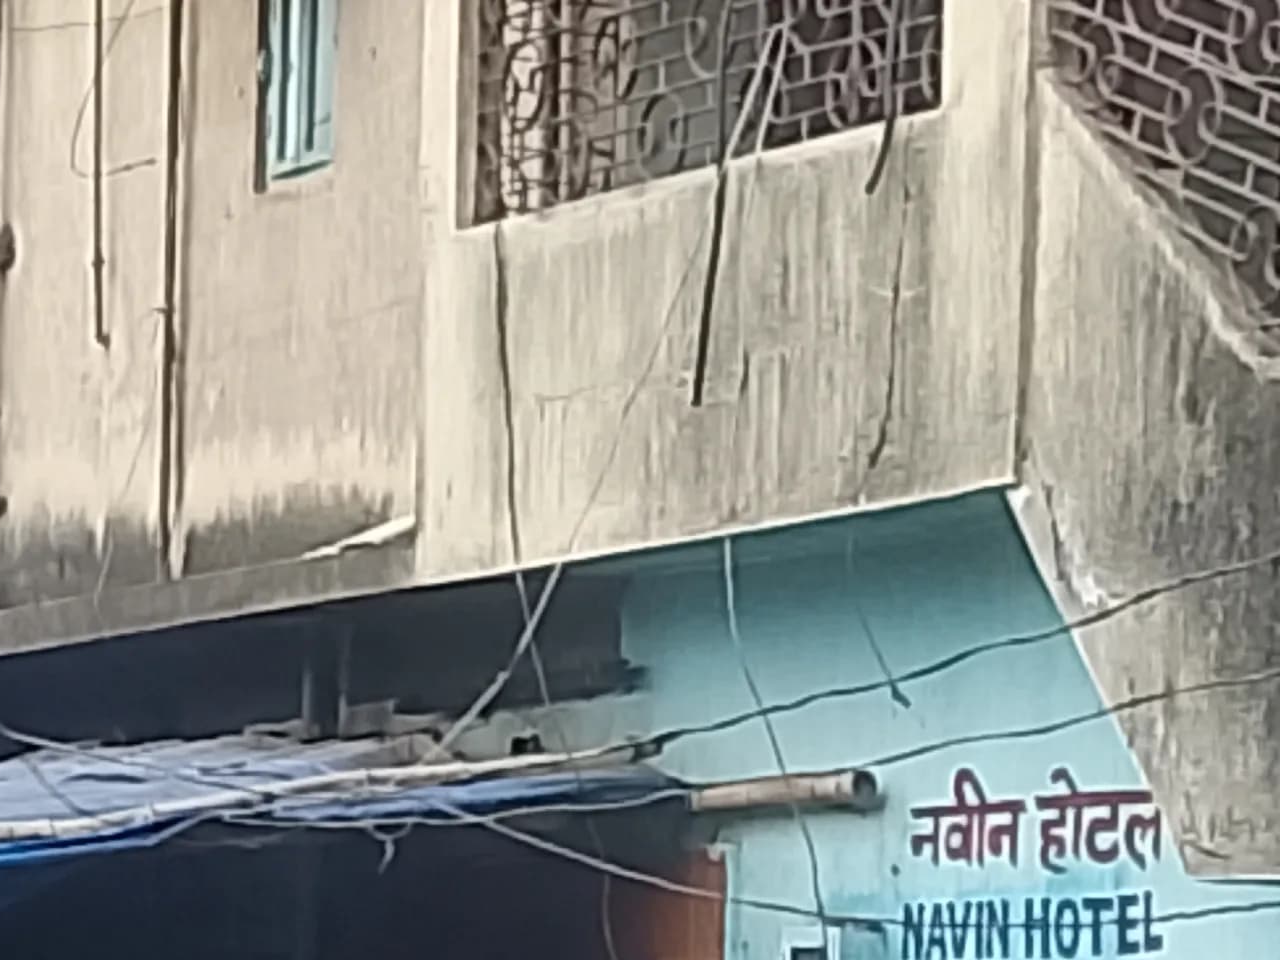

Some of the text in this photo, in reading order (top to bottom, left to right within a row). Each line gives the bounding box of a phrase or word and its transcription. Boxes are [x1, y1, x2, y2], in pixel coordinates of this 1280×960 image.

[910, 767, 1162, 874] नवीन होटल
[1023, 890, 1163, 960] HOTEL
